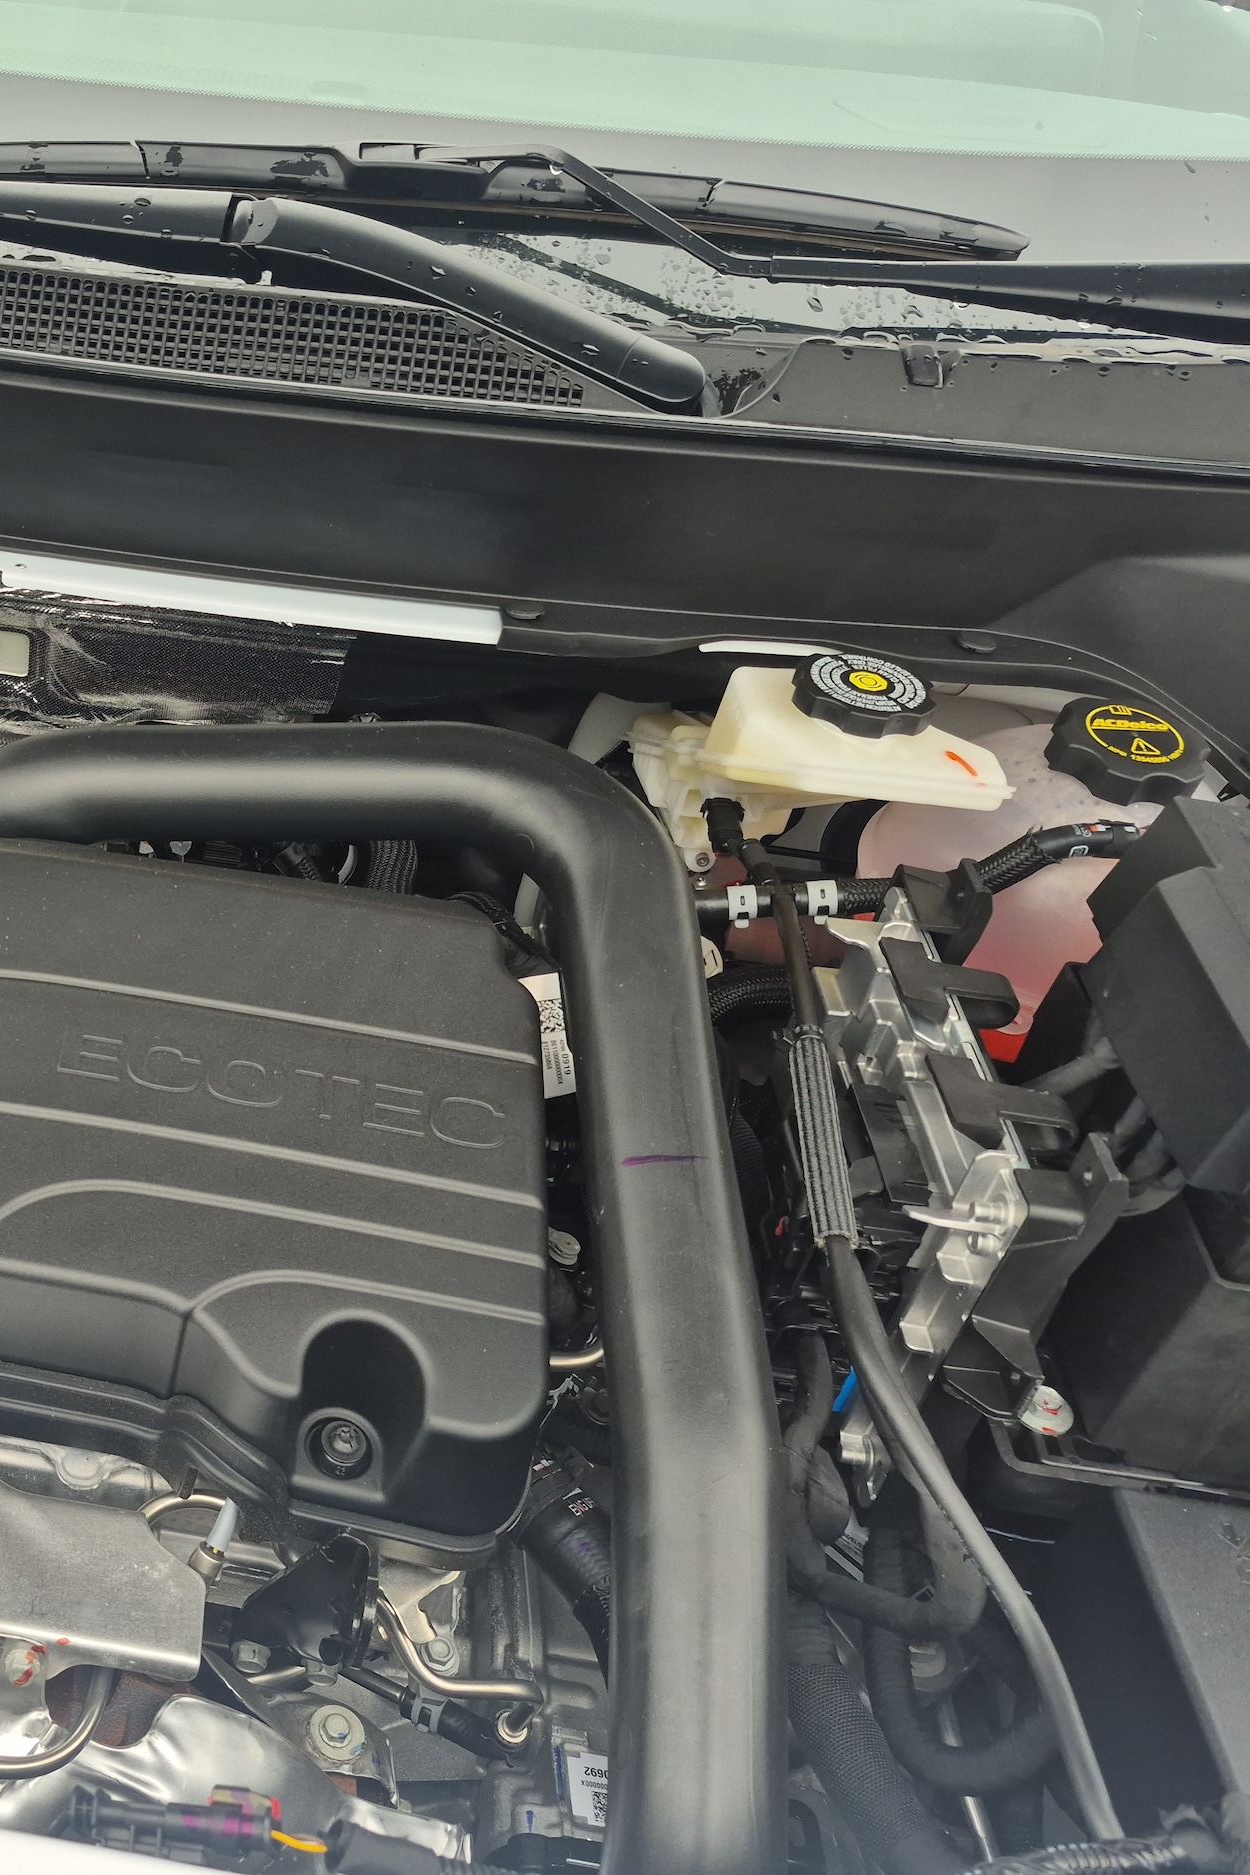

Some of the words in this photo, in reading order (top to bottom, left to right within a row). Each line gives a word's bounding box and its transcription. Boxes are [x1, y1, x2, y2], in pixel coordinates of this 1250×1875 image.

[1091, 718, 1170, 733] ACDelco
[562, 1053, 572, 1075] 0919
[57, 1034, 505, 1149] ECOTEC
